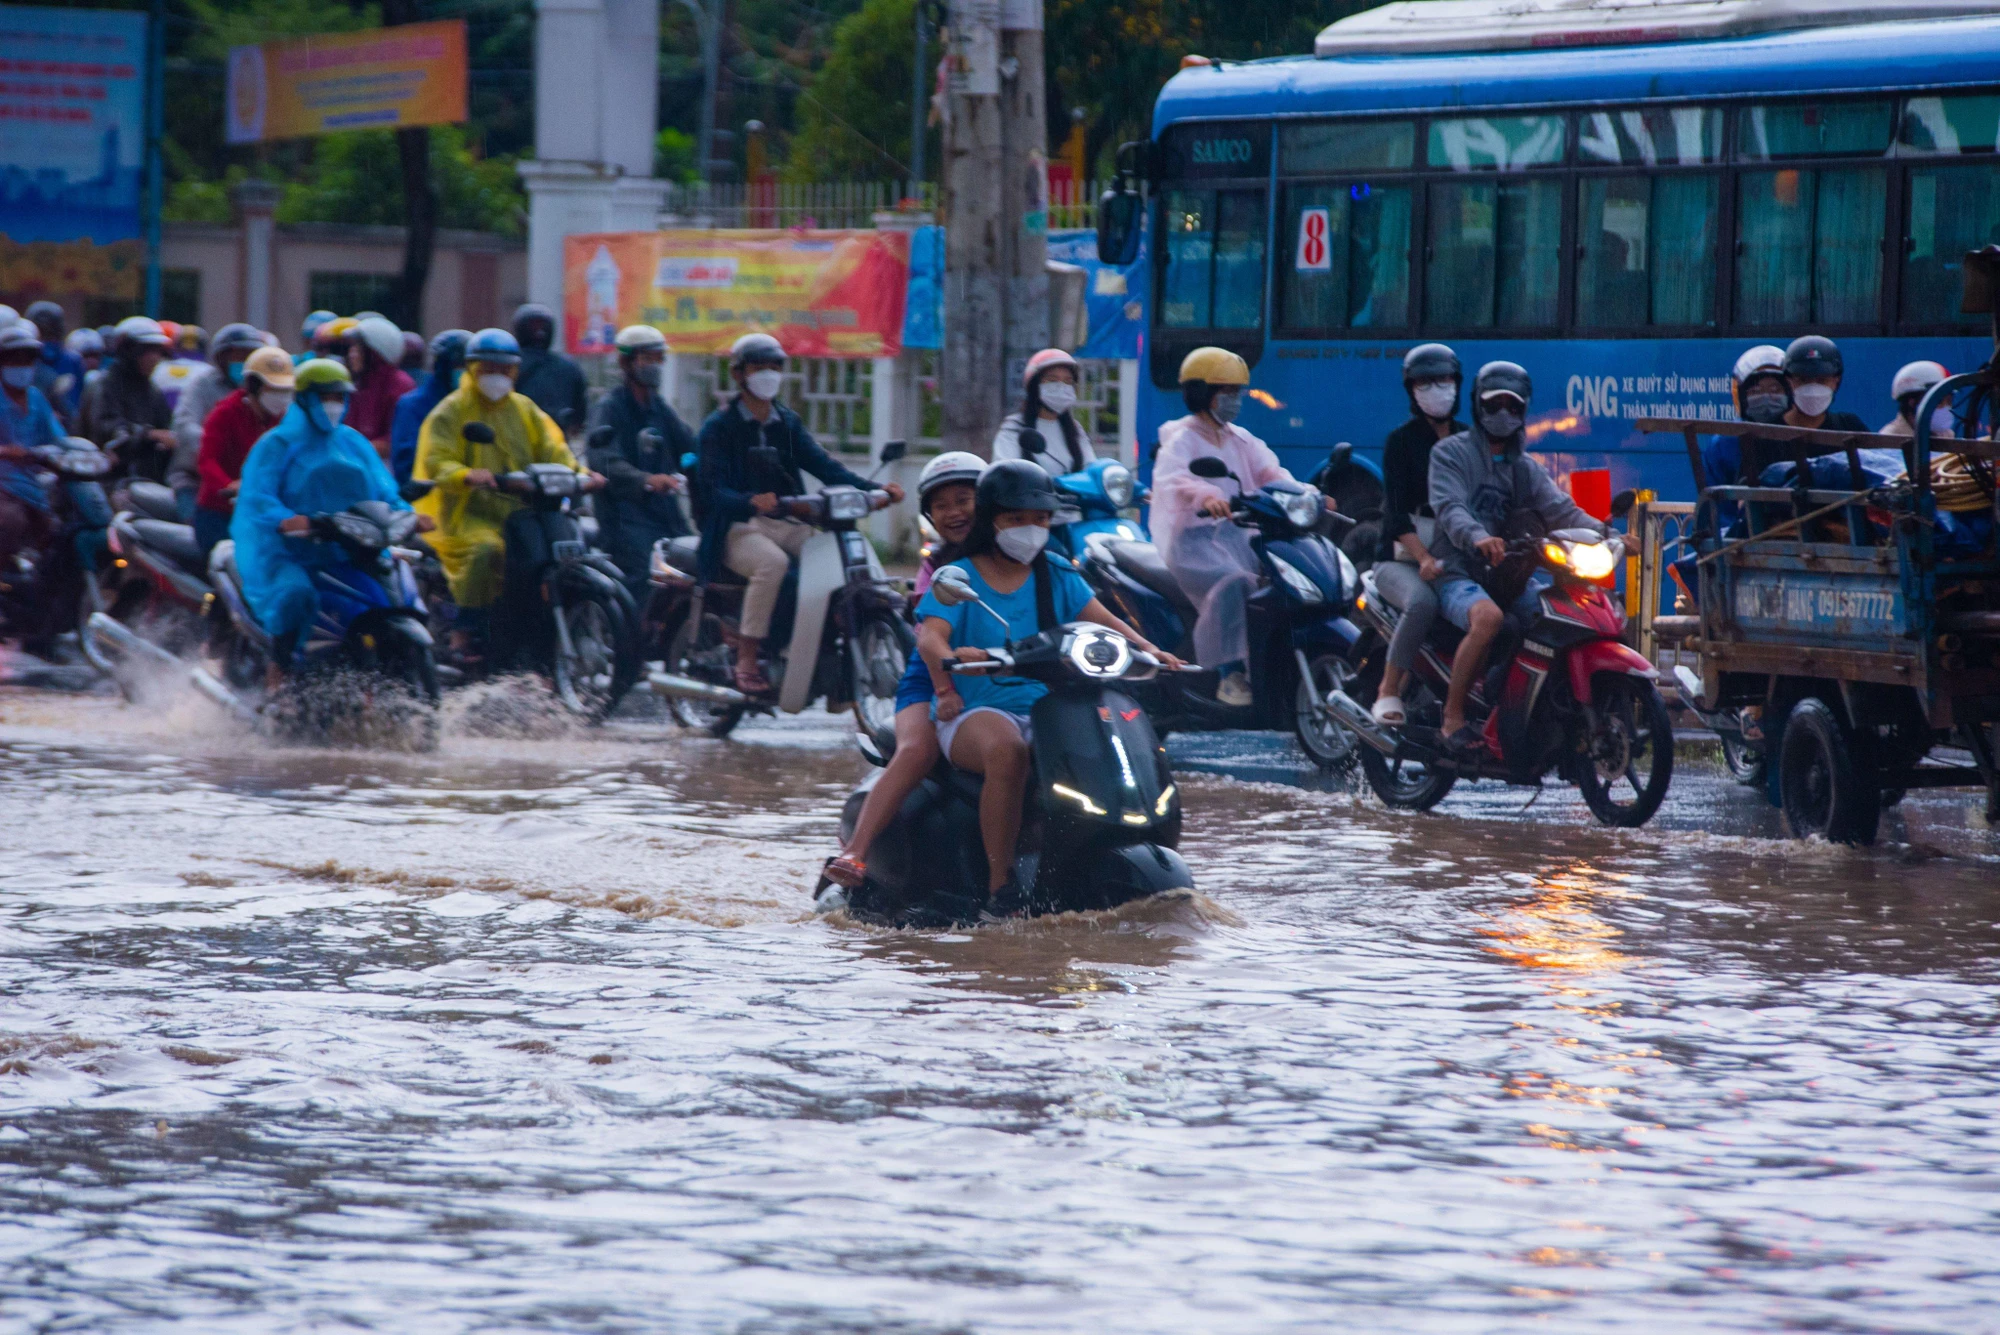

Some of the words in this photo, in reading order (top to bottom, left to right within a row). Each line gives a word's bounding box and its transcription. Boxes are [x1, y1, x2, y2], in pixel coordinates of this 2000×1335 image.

[1192, 139, 1250, 163] SAMCO
[1304, 213, 1324, 265] 8
[1566, 374, 1618, 418] CNG
[1622, 376, 1634, 393] XE
[1637, 373, 1662, 393] BUÝT
